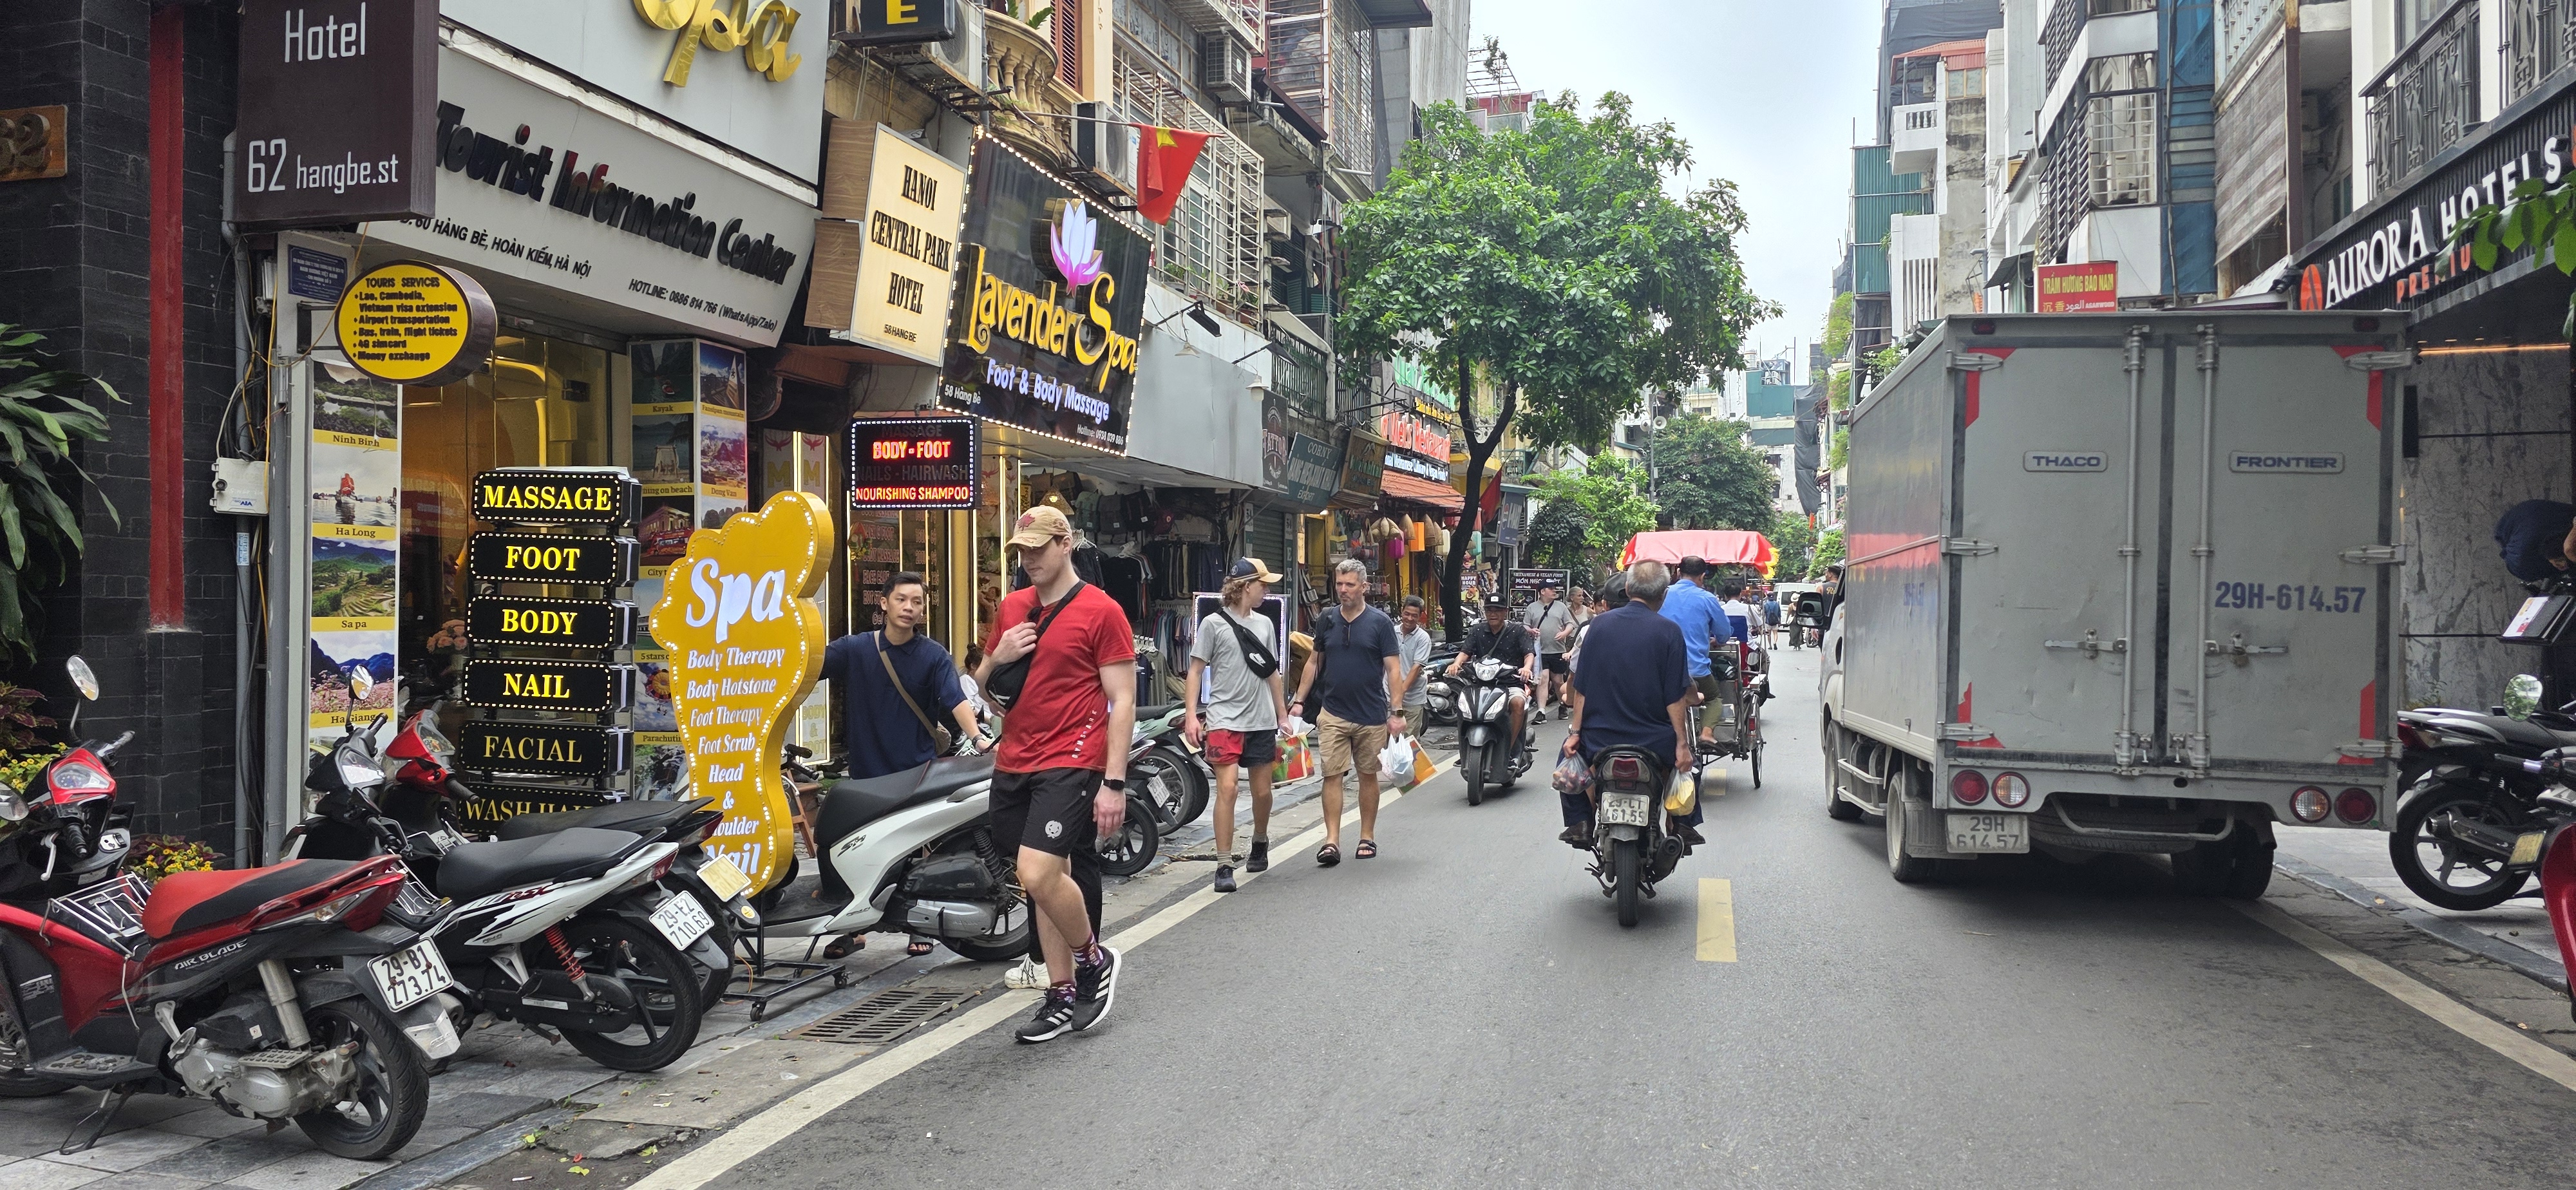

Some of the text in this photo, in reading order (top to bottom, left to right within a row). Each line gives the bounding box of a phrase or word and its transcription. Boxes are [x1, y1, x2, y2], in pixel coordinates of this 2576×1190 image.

[284, 2, 366, 63] Hotel
[247, 138, 399, 194] 62 hangbe.st
[436, 99, 797, 285] Tourist Information Center
[901, 164, 938, 211] HANOI
[433, 218, 468, 241] HÀNG
[470, 229, 488, 250] BÈ,
[491, 236, 524, 258] HOÀN
[526, 246, 553, 269] KIẾM,
[554, 254, 570, 271] HÀ
[572, 260, 591, 279] NỘI
[871, 210, 952, 272] CENTRAL PARK
[2325, 207, 2430, 310] AURORA
[365, 277, 440, 288] TOURIS SERVICES
[2099, 274, 2114, 291] NAM
[2396, 242, 2471, 304] PREIU
[359, 290, 425, 301] Lao, Cambodia,
[629, 278, 668, 299] HOTLINE:
[669, 290, 690, 305] 0886
[689, 297, 704, 310] 814
[886, 272, 924, 314] HOTEL
[359, 302, 458, 312] Vietnam visa extension
[967, 243, 1138, 393] Lavender Spa
[358, 315, 450, 325] Airport transportation
[379, 327, 402, 337] train,
[404, 327, 426, 337] flight
[429, 326, 458, 337] tickets
[358, 339, 370, 348] 4G
[357, 351, 430, 361] Money exchange
[944, 384, 981, 405] 58 Hàng Bè
[987, 358, 1110, 424] Foot & Body Massage
[652, 405, 674, 413] Kayak
[333, 435, 379, 447] Ninh Binh
[882, 425, 942, 437] MASSAGE
[873, 441, 907, 459] BODY
[916, 440, 951, 458] FOOT
[857, 464, 968, 481] NAILS HAIRWASH
[2032, 456, 2101, 468] THACO
[2236, 456, 2337, 469] FRONTIER
[482, 484, 612, 511] MASSAGE
[711, 487, 726, 497] Dong
[856, 487, 969, 500] NOURISHING SHAMPOO
[336, 527, 375, 538] Ha Long
[504, 545, 581, 572] FOOT
[648, 569, 664, 577] City
[685, 558, 785, 643] Spa
[2214, 581, 2366, 614] 29H-614.57
[341, 620, 367, 630] Sa pa
[501, 608, 578, 636] BODY
[687, 647, 785, 671] Body Therapy
[502, 672, 571, 699] NAIL
[687, 677, 777, 701] Body Hotstone
[689, 705, 762, 727] Foot Therapy
[483, 735, 582, 763] FACIAL
[697, 732, 755, 755] Foot Scrub
[708, 763, 744, 783] Head
[466, 798, 532, 821] WASH
[723, 791, 734, 809] &
[712, 816, 760, 836] oulder
[1971, 816, 2005, 832] 29H
[670, 911, 710, 947] 710.69
[175, 958, 198, 970] AIR
[198, 938, 247, 961] BLADE
[381, 945, 432, 979] 29-B1
[388, 965, 446, 1006] 273.74
